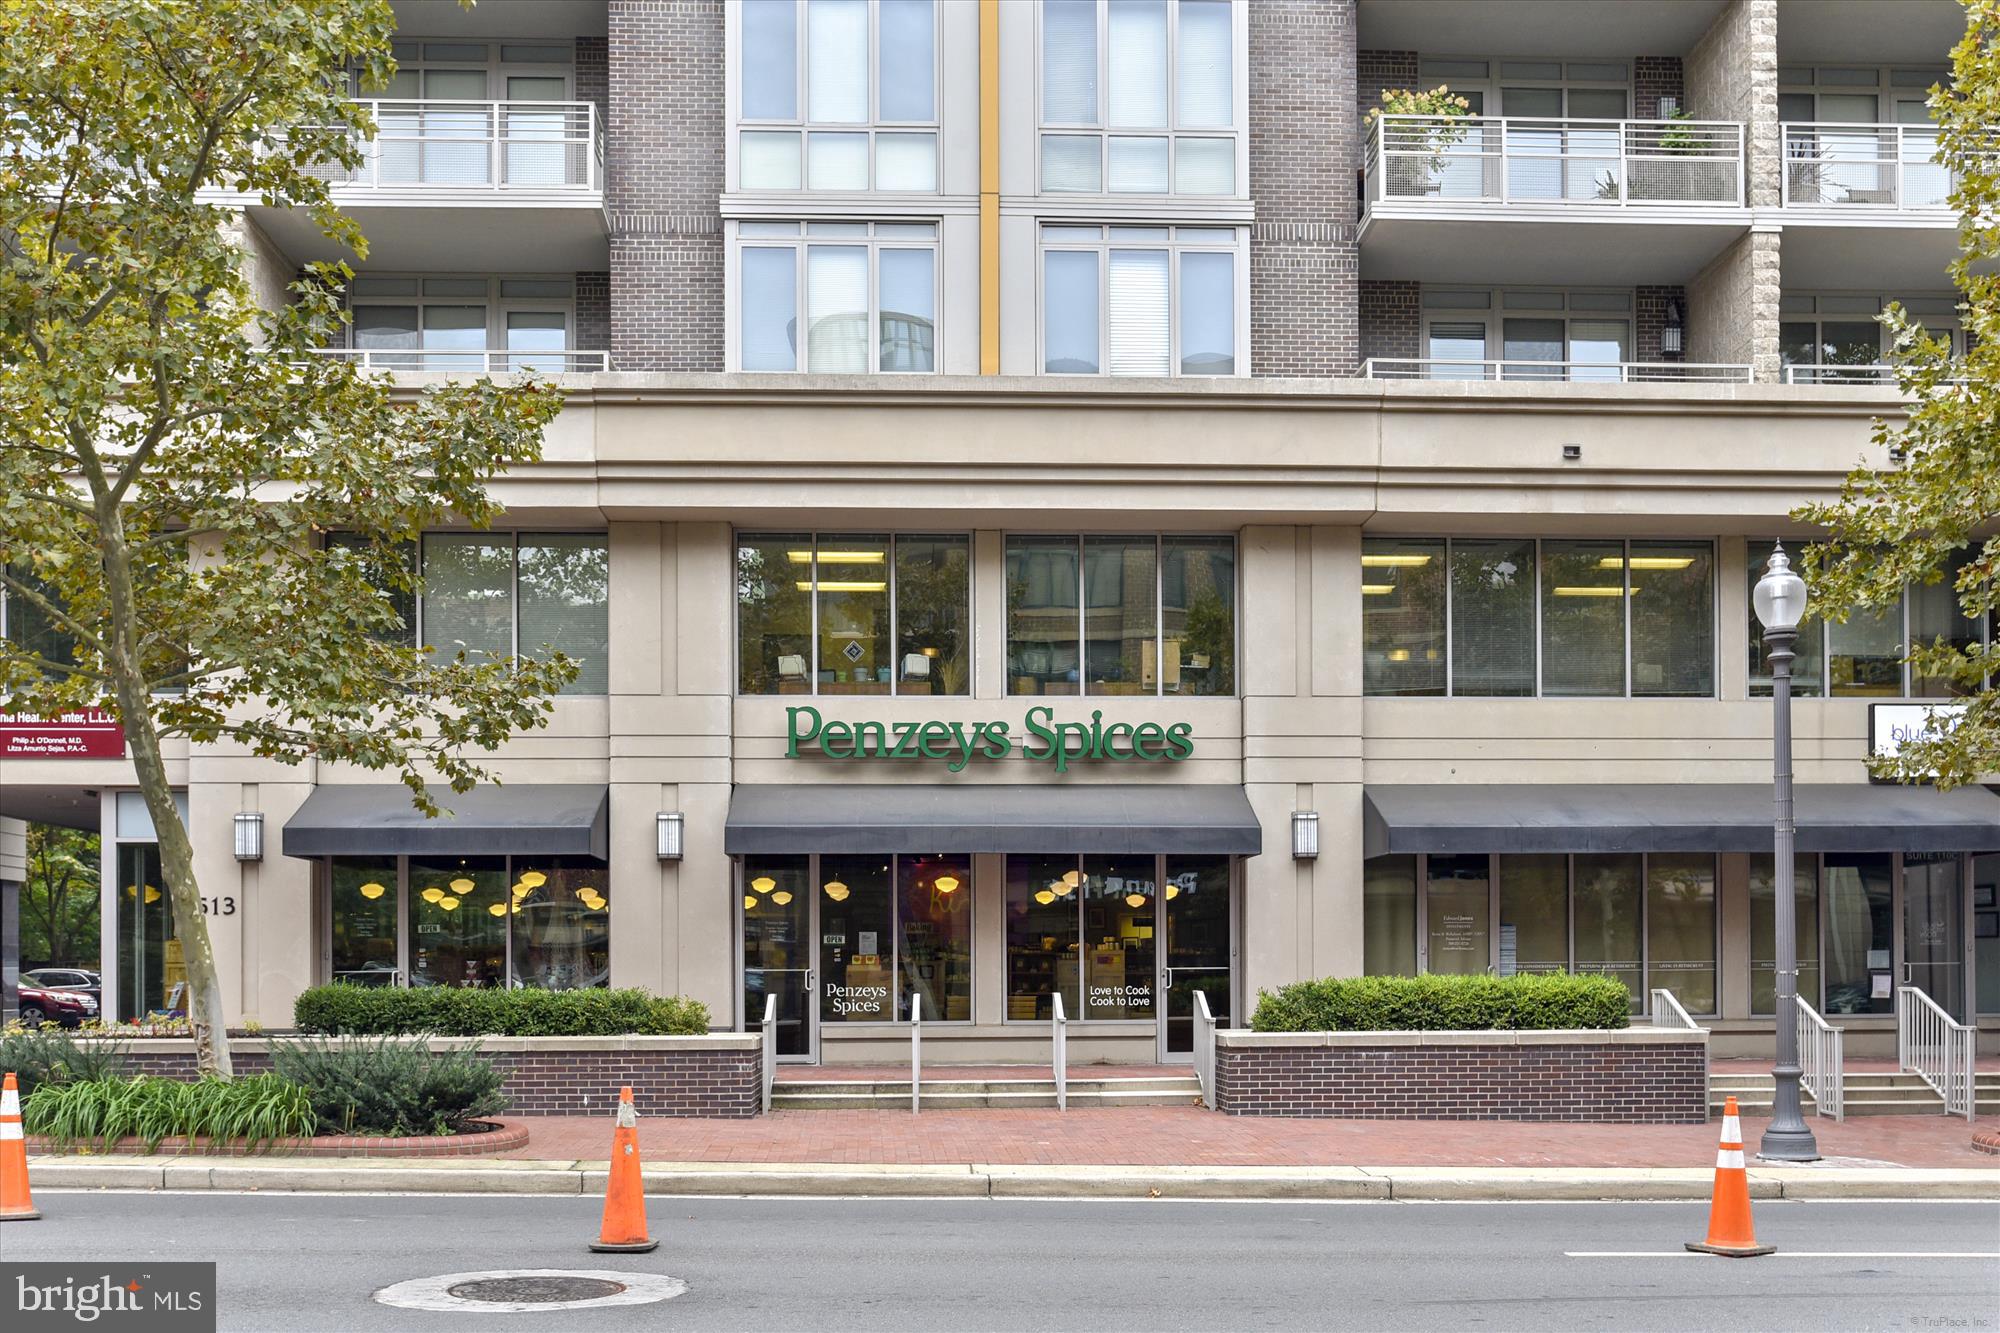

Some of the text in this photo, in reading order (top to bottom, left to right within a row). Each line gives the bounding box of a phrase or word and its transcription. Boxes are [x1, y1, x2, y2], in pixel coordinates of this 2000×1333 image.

[17, 711, 49, 723] Heal
[51, 711, 87, 725] enter,
[785, 706, 1193, 773] Penzeys Spices
[1906, 852, 1933, 860] SUITE
[826, 983, 887, 1000] Penzeys
[1090, 985, 1150, 995] Love to Cook
[833, 998, 880, 1015] Spices
[1090, 996, 1150, 1006] Cook to Love
